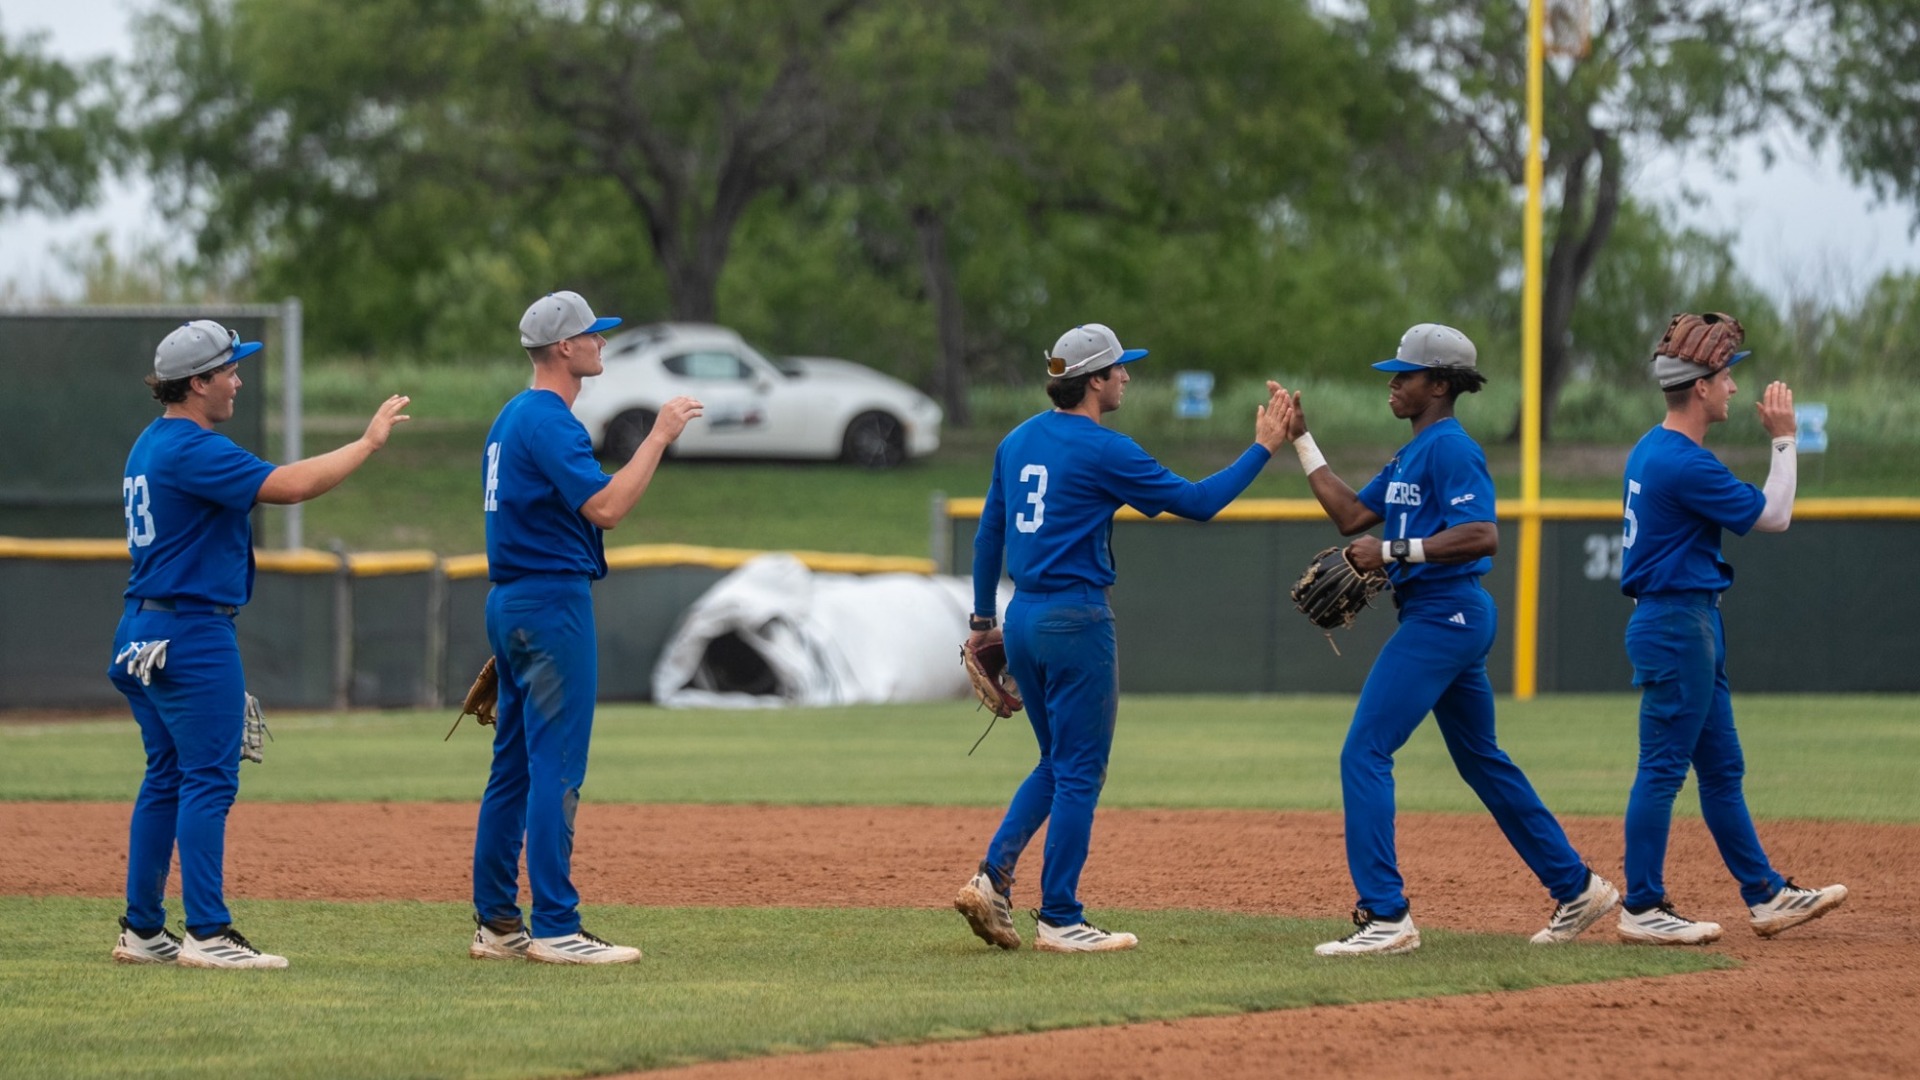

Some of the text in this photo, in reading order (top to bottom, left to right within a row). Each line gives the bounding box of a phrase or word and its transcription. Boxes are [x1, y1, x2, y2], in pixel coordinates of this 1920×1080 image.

[123, 474, 156, 548] 33
[1015, 463, 1049, 534] 3
[1399, 512, 1408, 540] 1
[1622, 478, 1642, 550] 5
